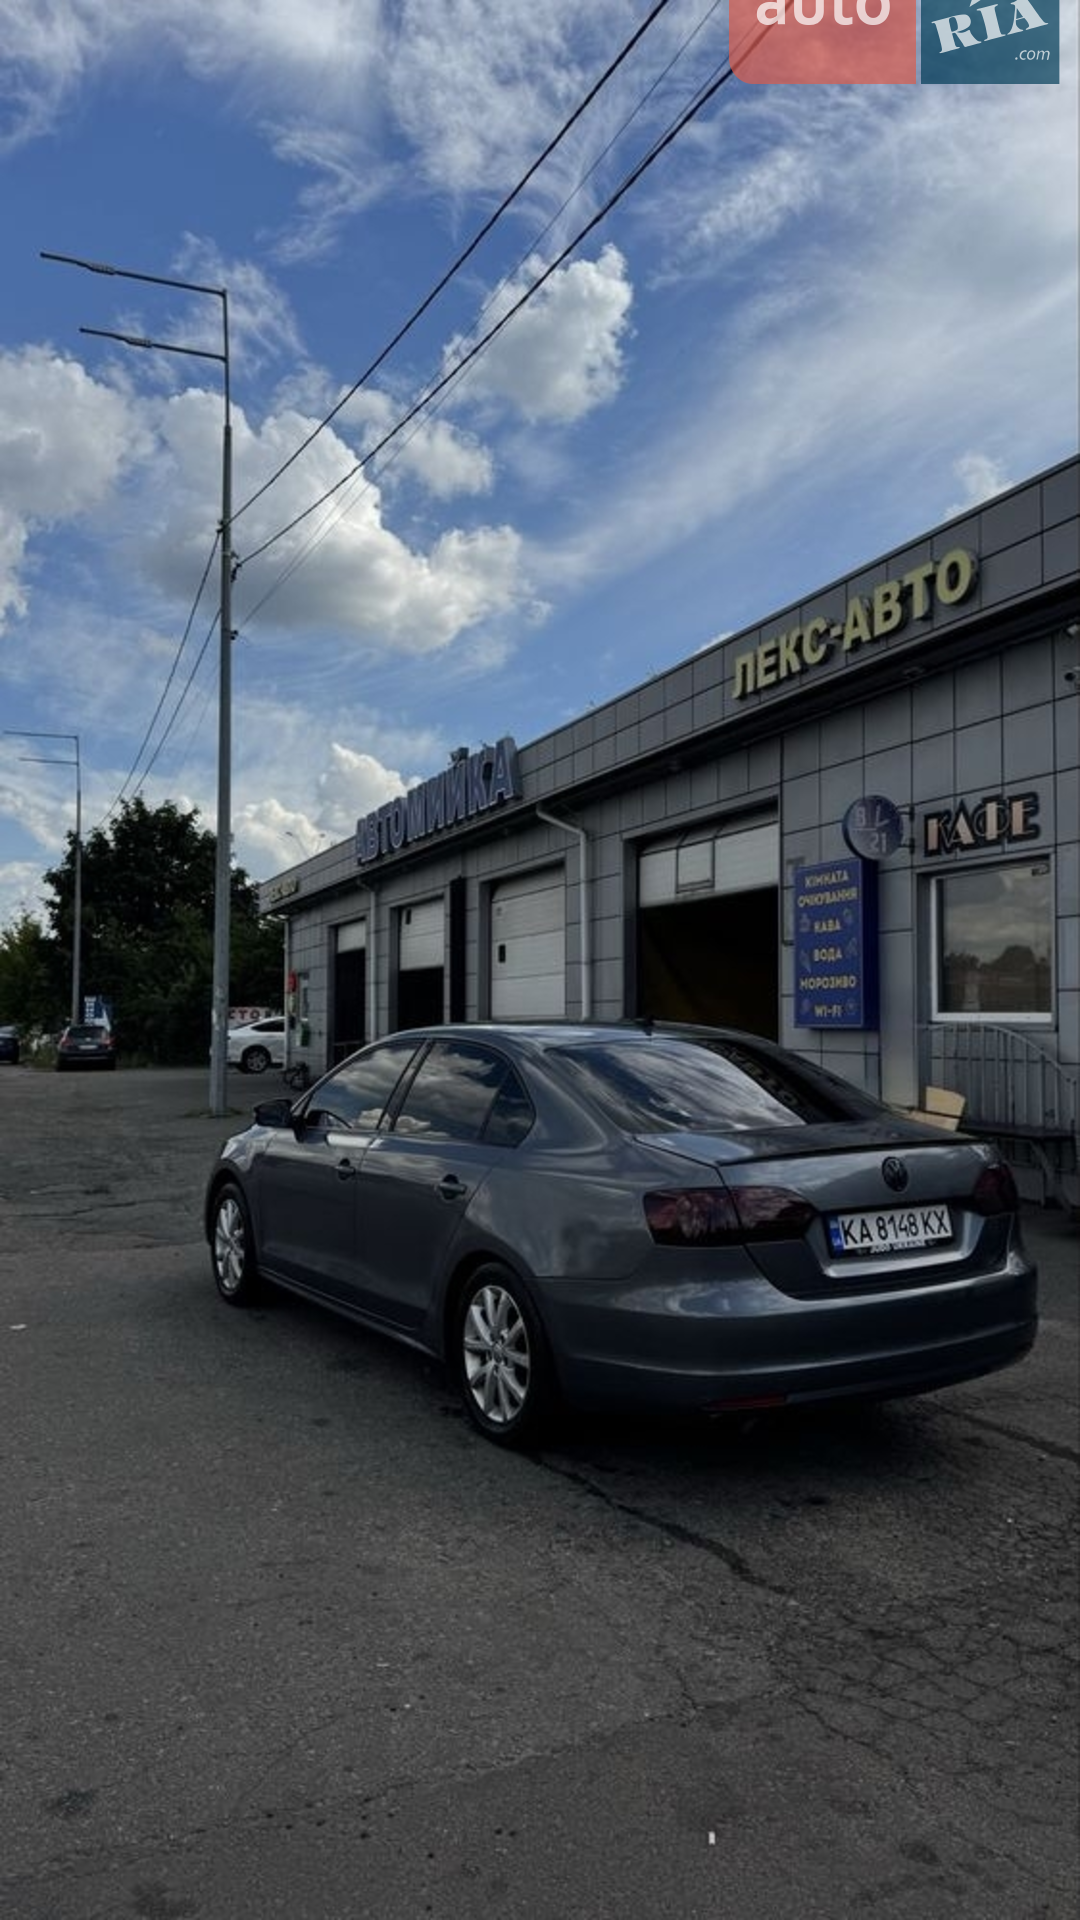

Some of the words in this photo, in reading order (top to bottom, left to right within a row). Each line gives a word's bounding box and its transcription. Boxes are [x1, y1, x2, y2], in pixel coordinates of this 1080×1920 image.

[731, 549, 974, 699] ЛЕКС-АВТО
[355, 736, 517, 866] АВТОМИЙКА
[925, 794, 1039, 856] КАФЕ
[870, 832, 888, 853] 21
[804, 870, 849, 888] КІМНАТА
[813, 919, 841, 932] КАВА
[813, 947, 842, 962] ВОДА
[799, 974, 858, 990] МОРОЗИВО
[840, 1217, 874, 1246] KA
[876, 1211, 919, 1241] 8148
[920, 1210, 949, 1236] KX
